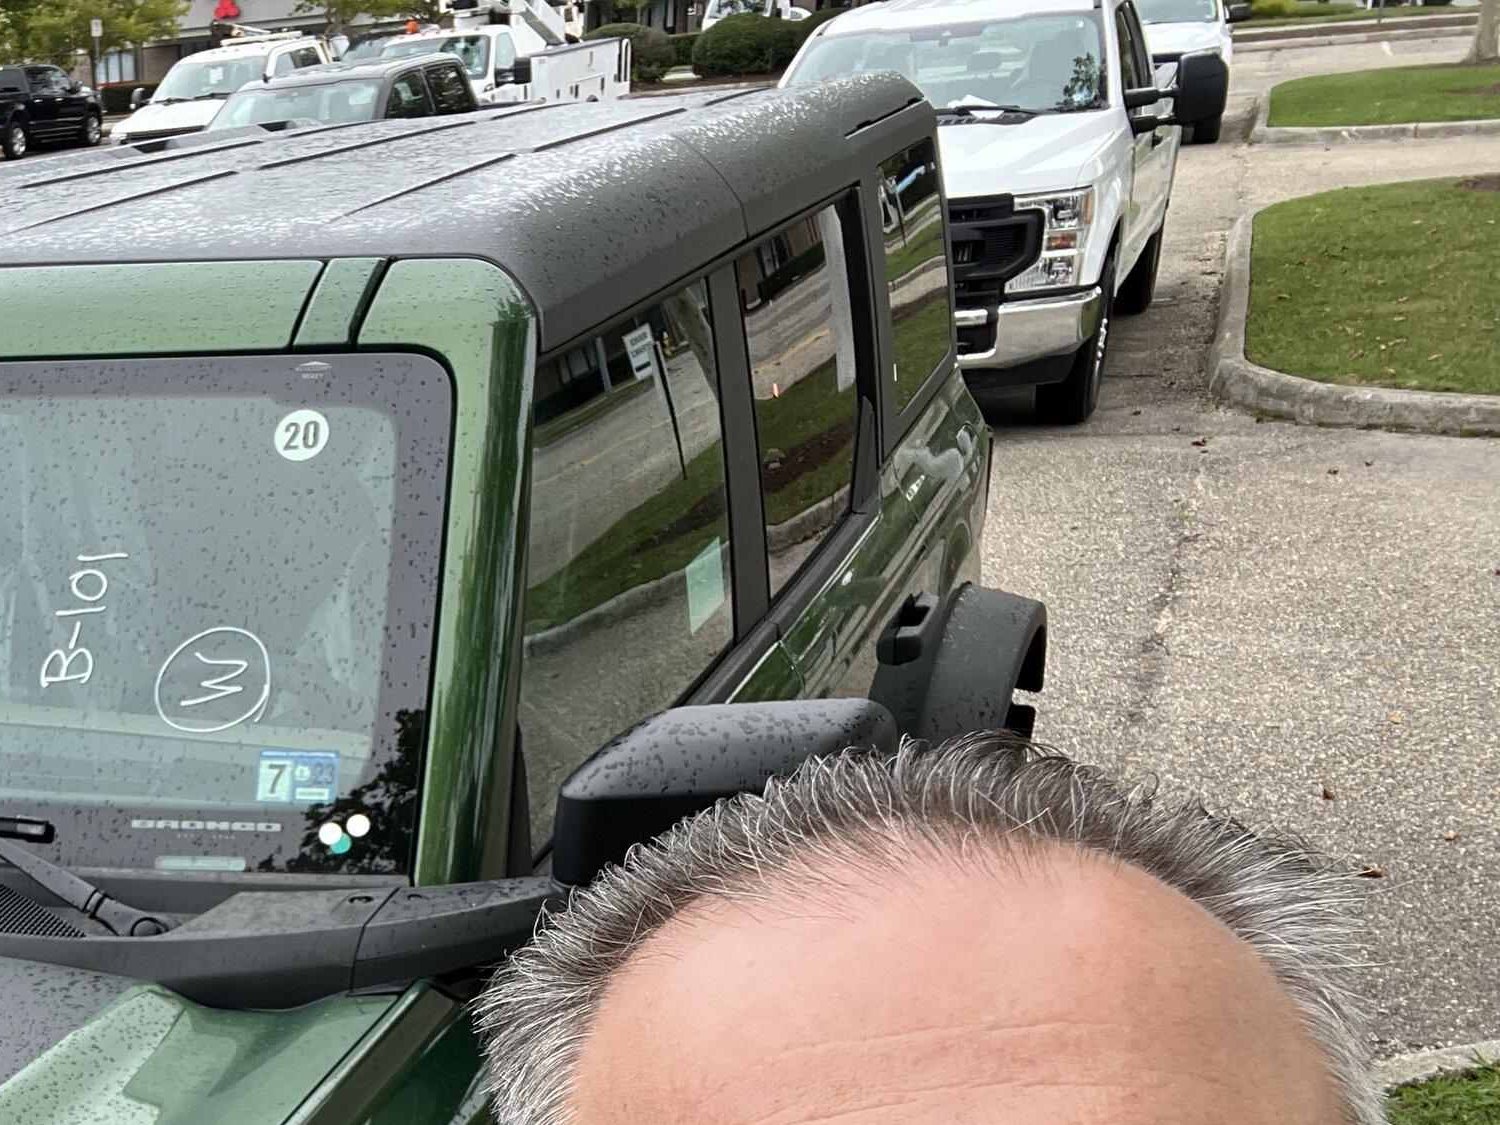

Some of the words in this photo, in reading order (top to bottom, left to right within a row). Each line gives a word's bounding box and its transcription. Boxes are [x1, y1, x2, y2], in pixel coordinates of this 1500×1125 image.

[283, 420, 320, 451] 20
[40, 552, 128, 688] B-101
[268, 763, 286, 795] 7
